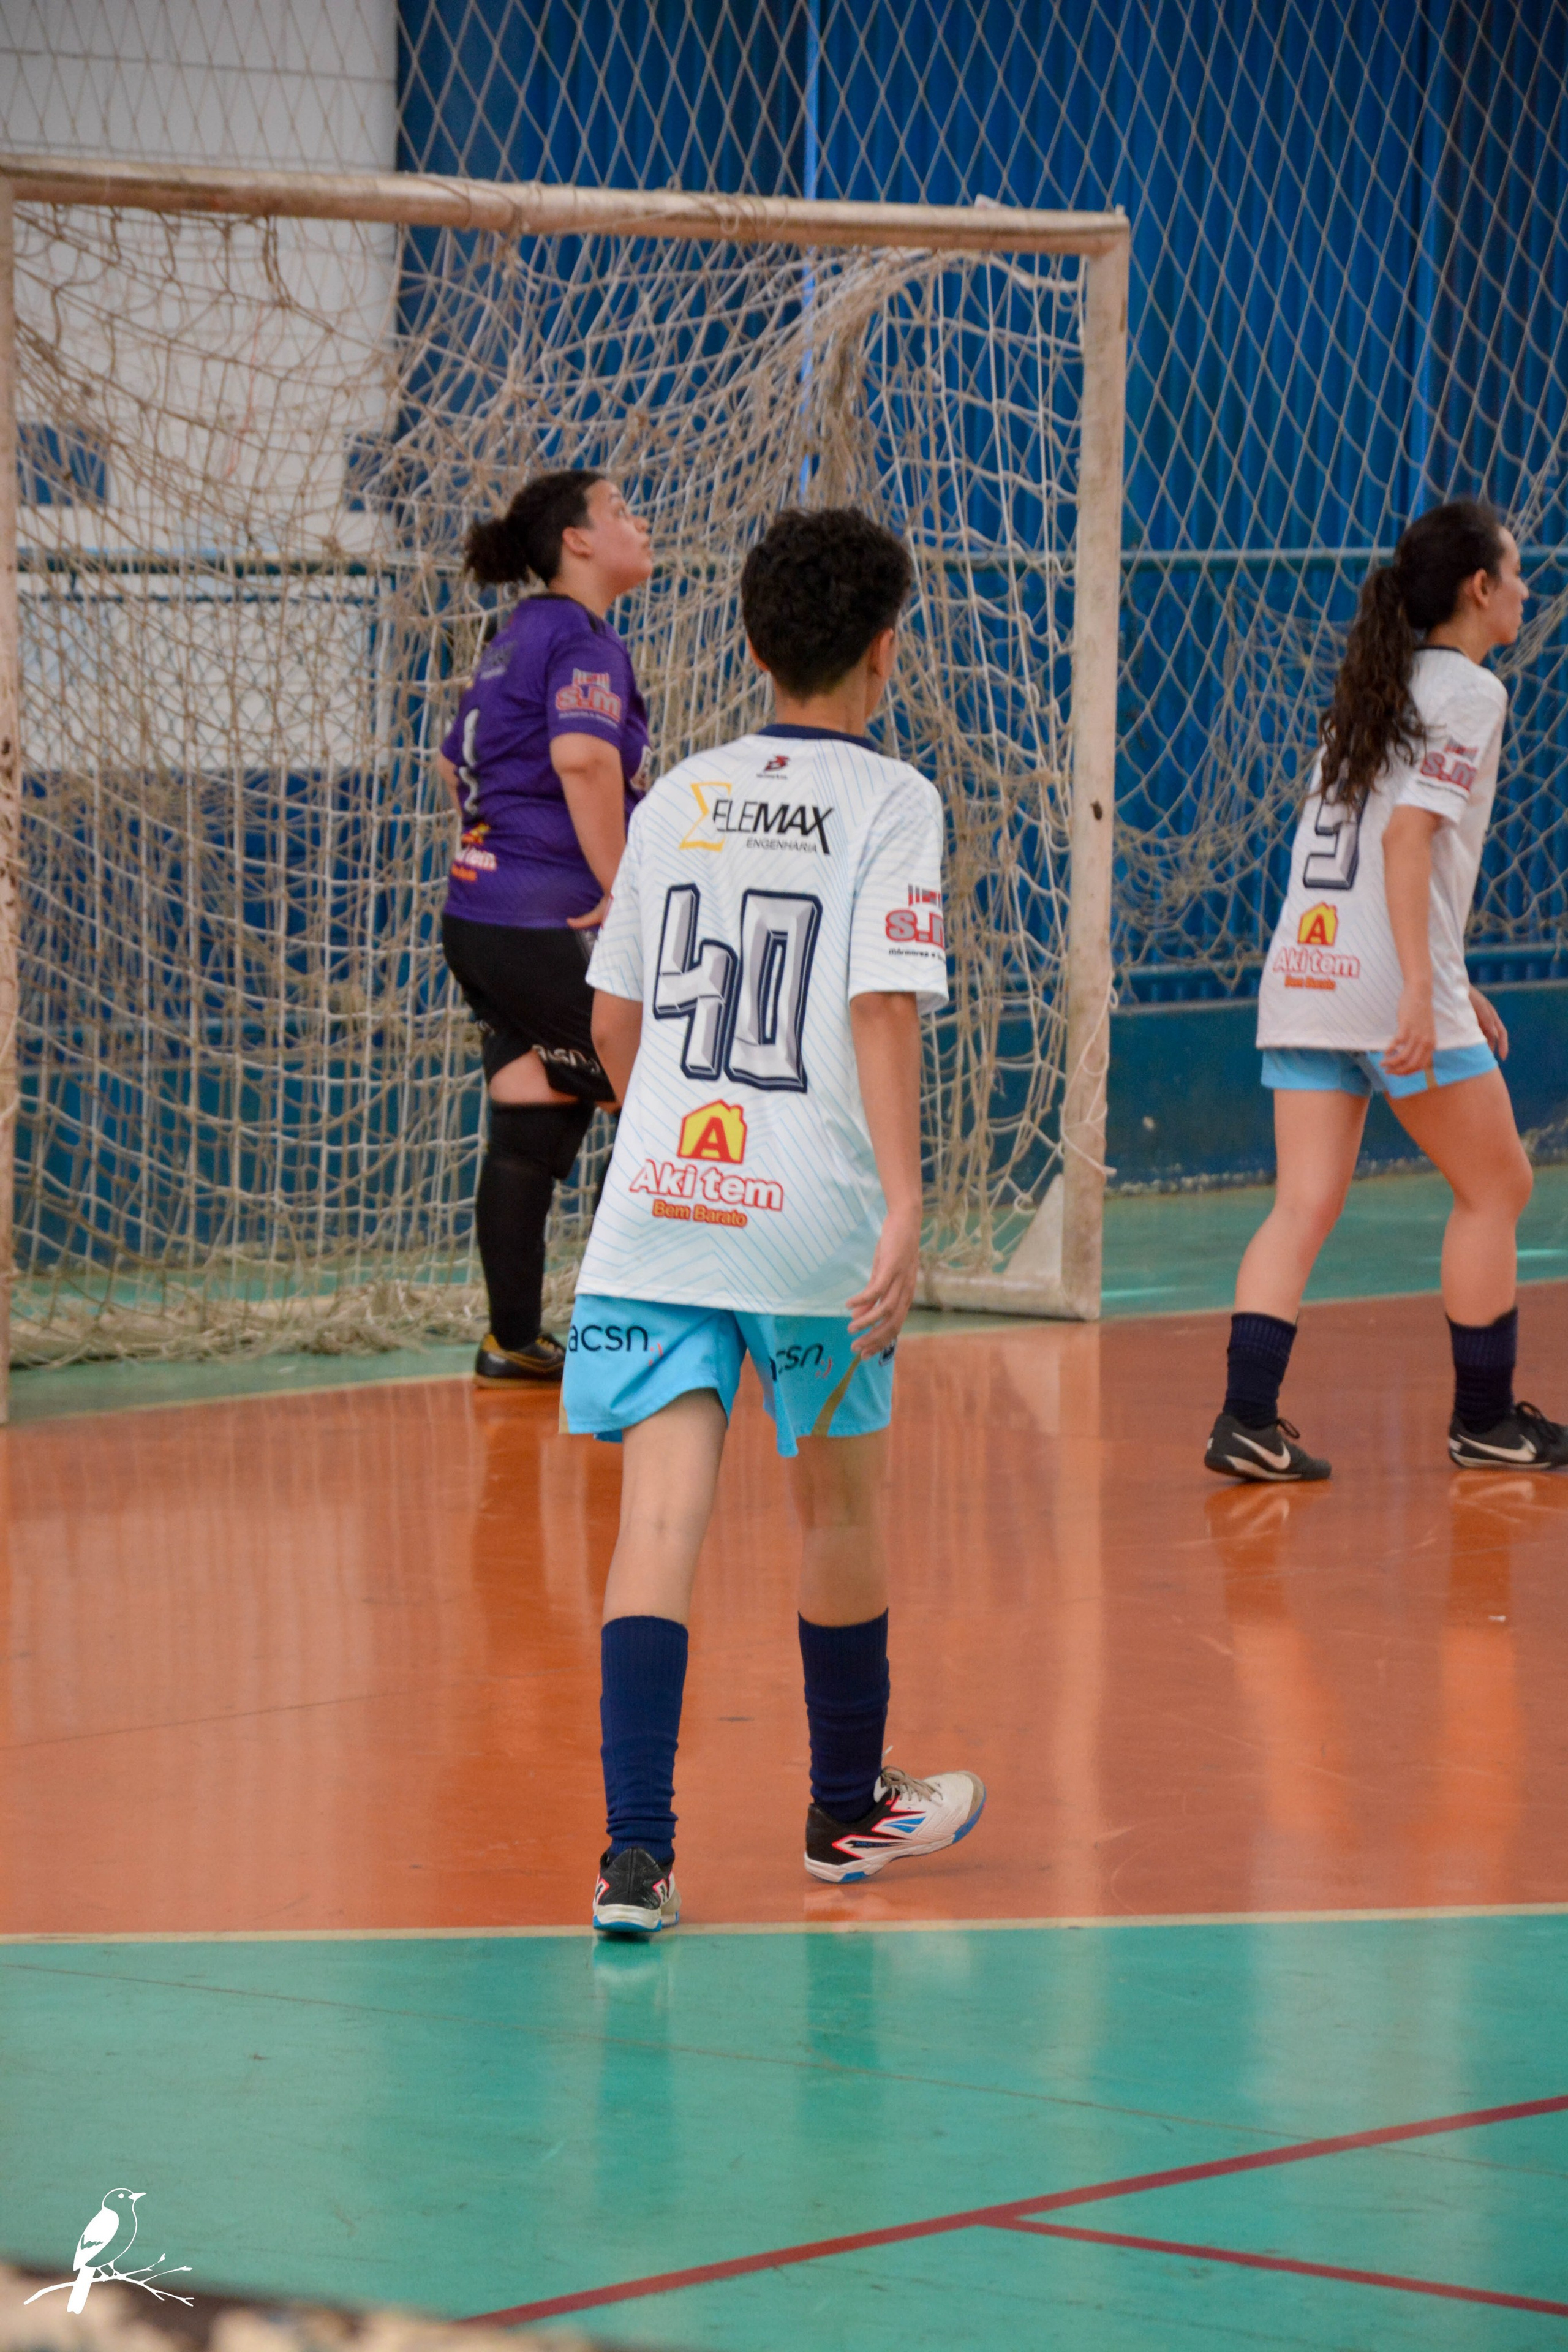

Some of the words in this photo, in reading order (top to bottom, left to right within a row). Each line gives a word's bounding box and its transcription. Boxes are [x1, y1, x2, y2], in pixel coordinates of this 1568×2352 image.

[713, 797, 834, 855] ELEMAX
[746, 837, 817, 853] ENGENHARIA
[1305, 914, 1329, 945] A
[654, 883, 823, 1093] 40
[690, 1116, 733, 1161] A
[630, 1158, 698, 1199] Aki
[700, 1166, 784, 1212] tem
[652, 1199, 691, 1220] Bom
[693, 1203, 748, 1229] Barato
